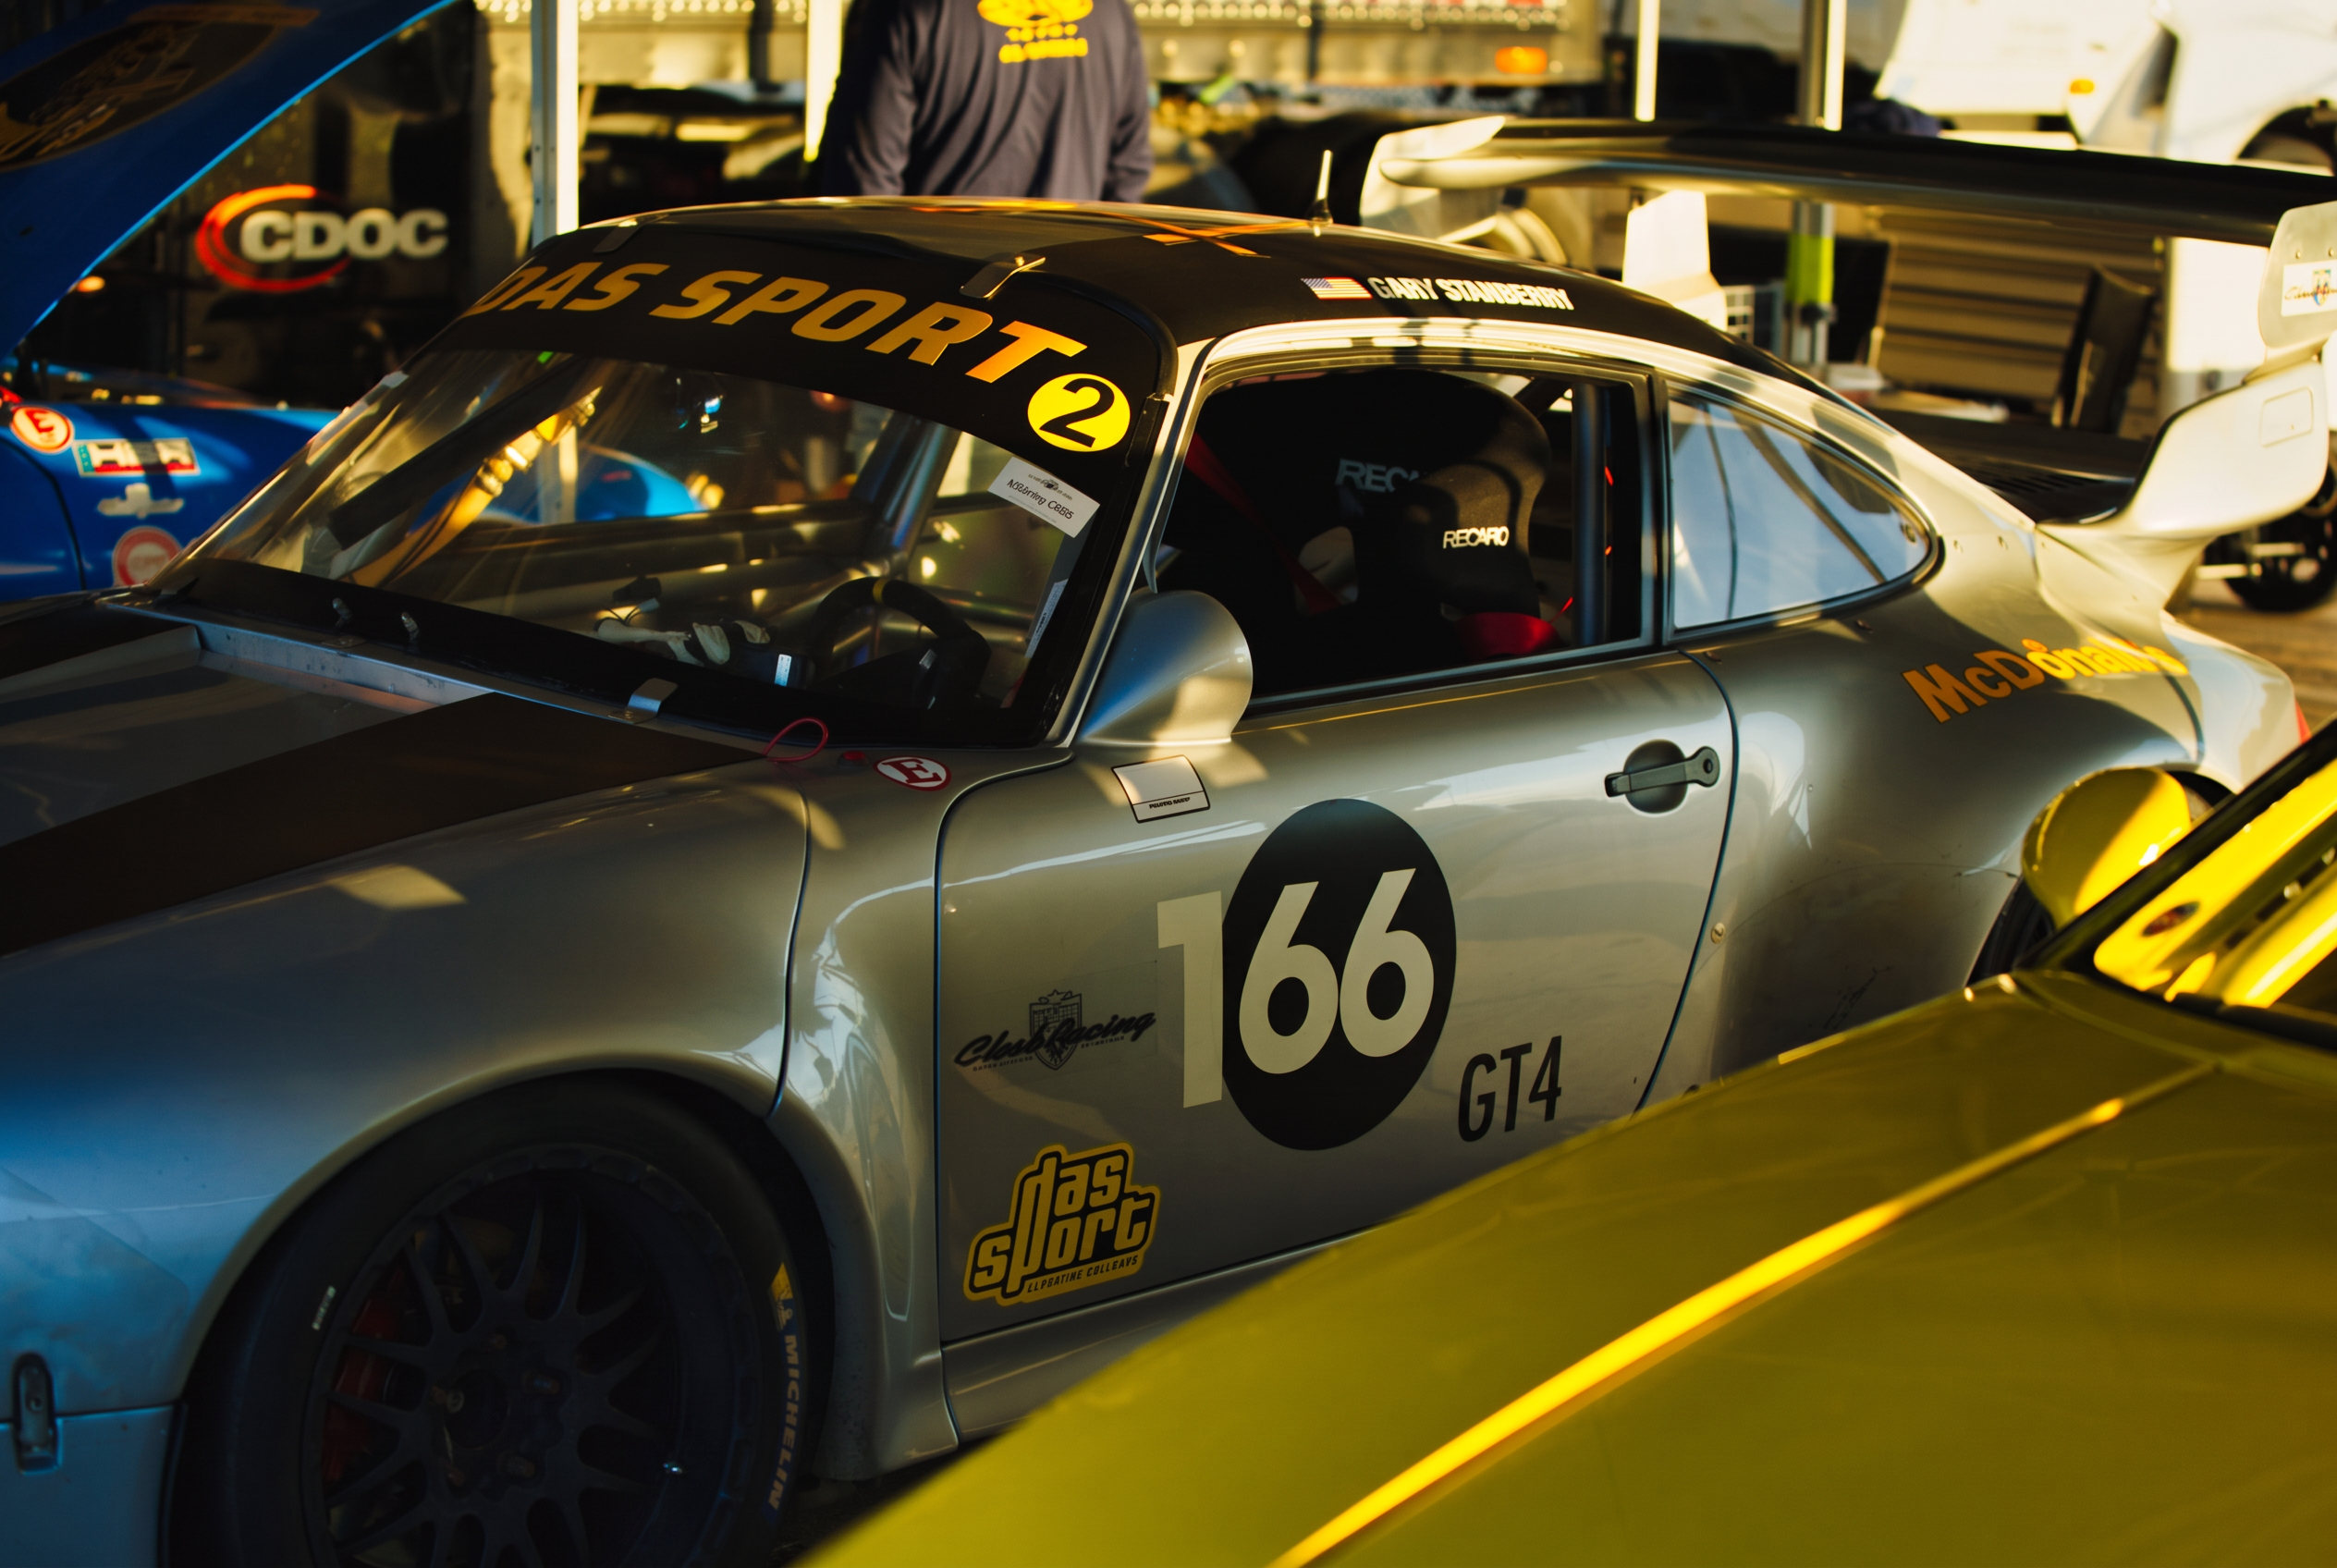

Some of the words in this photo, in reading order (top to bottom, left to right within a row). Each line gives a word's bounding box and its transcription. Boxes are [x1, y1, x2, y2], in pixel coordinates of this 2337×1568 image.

[239, 207, 449, 263] CDOC
[464, 261, 671, 312] DAS
[648, 270, 1087, 385] SPORT
[1367, 276, 1439, 300] GARY
[1435, 278, 1575, 311] STANBERRY
[1038, 376, 1116, 448] 2
[1335, 458, 1420, 494] REC
[1442, 525, 1510, 549] RECARO
[881, 757, 943, 785] E
[1156, 867, 1435, 1109] 166
[1044, 1011, 1156, 1049] Racing
[1457, 1035, 1562, 1143] GT4
[1022, 1154, 1125, 1218] das
[767, 1334, 800, 1511] MICHELIN
